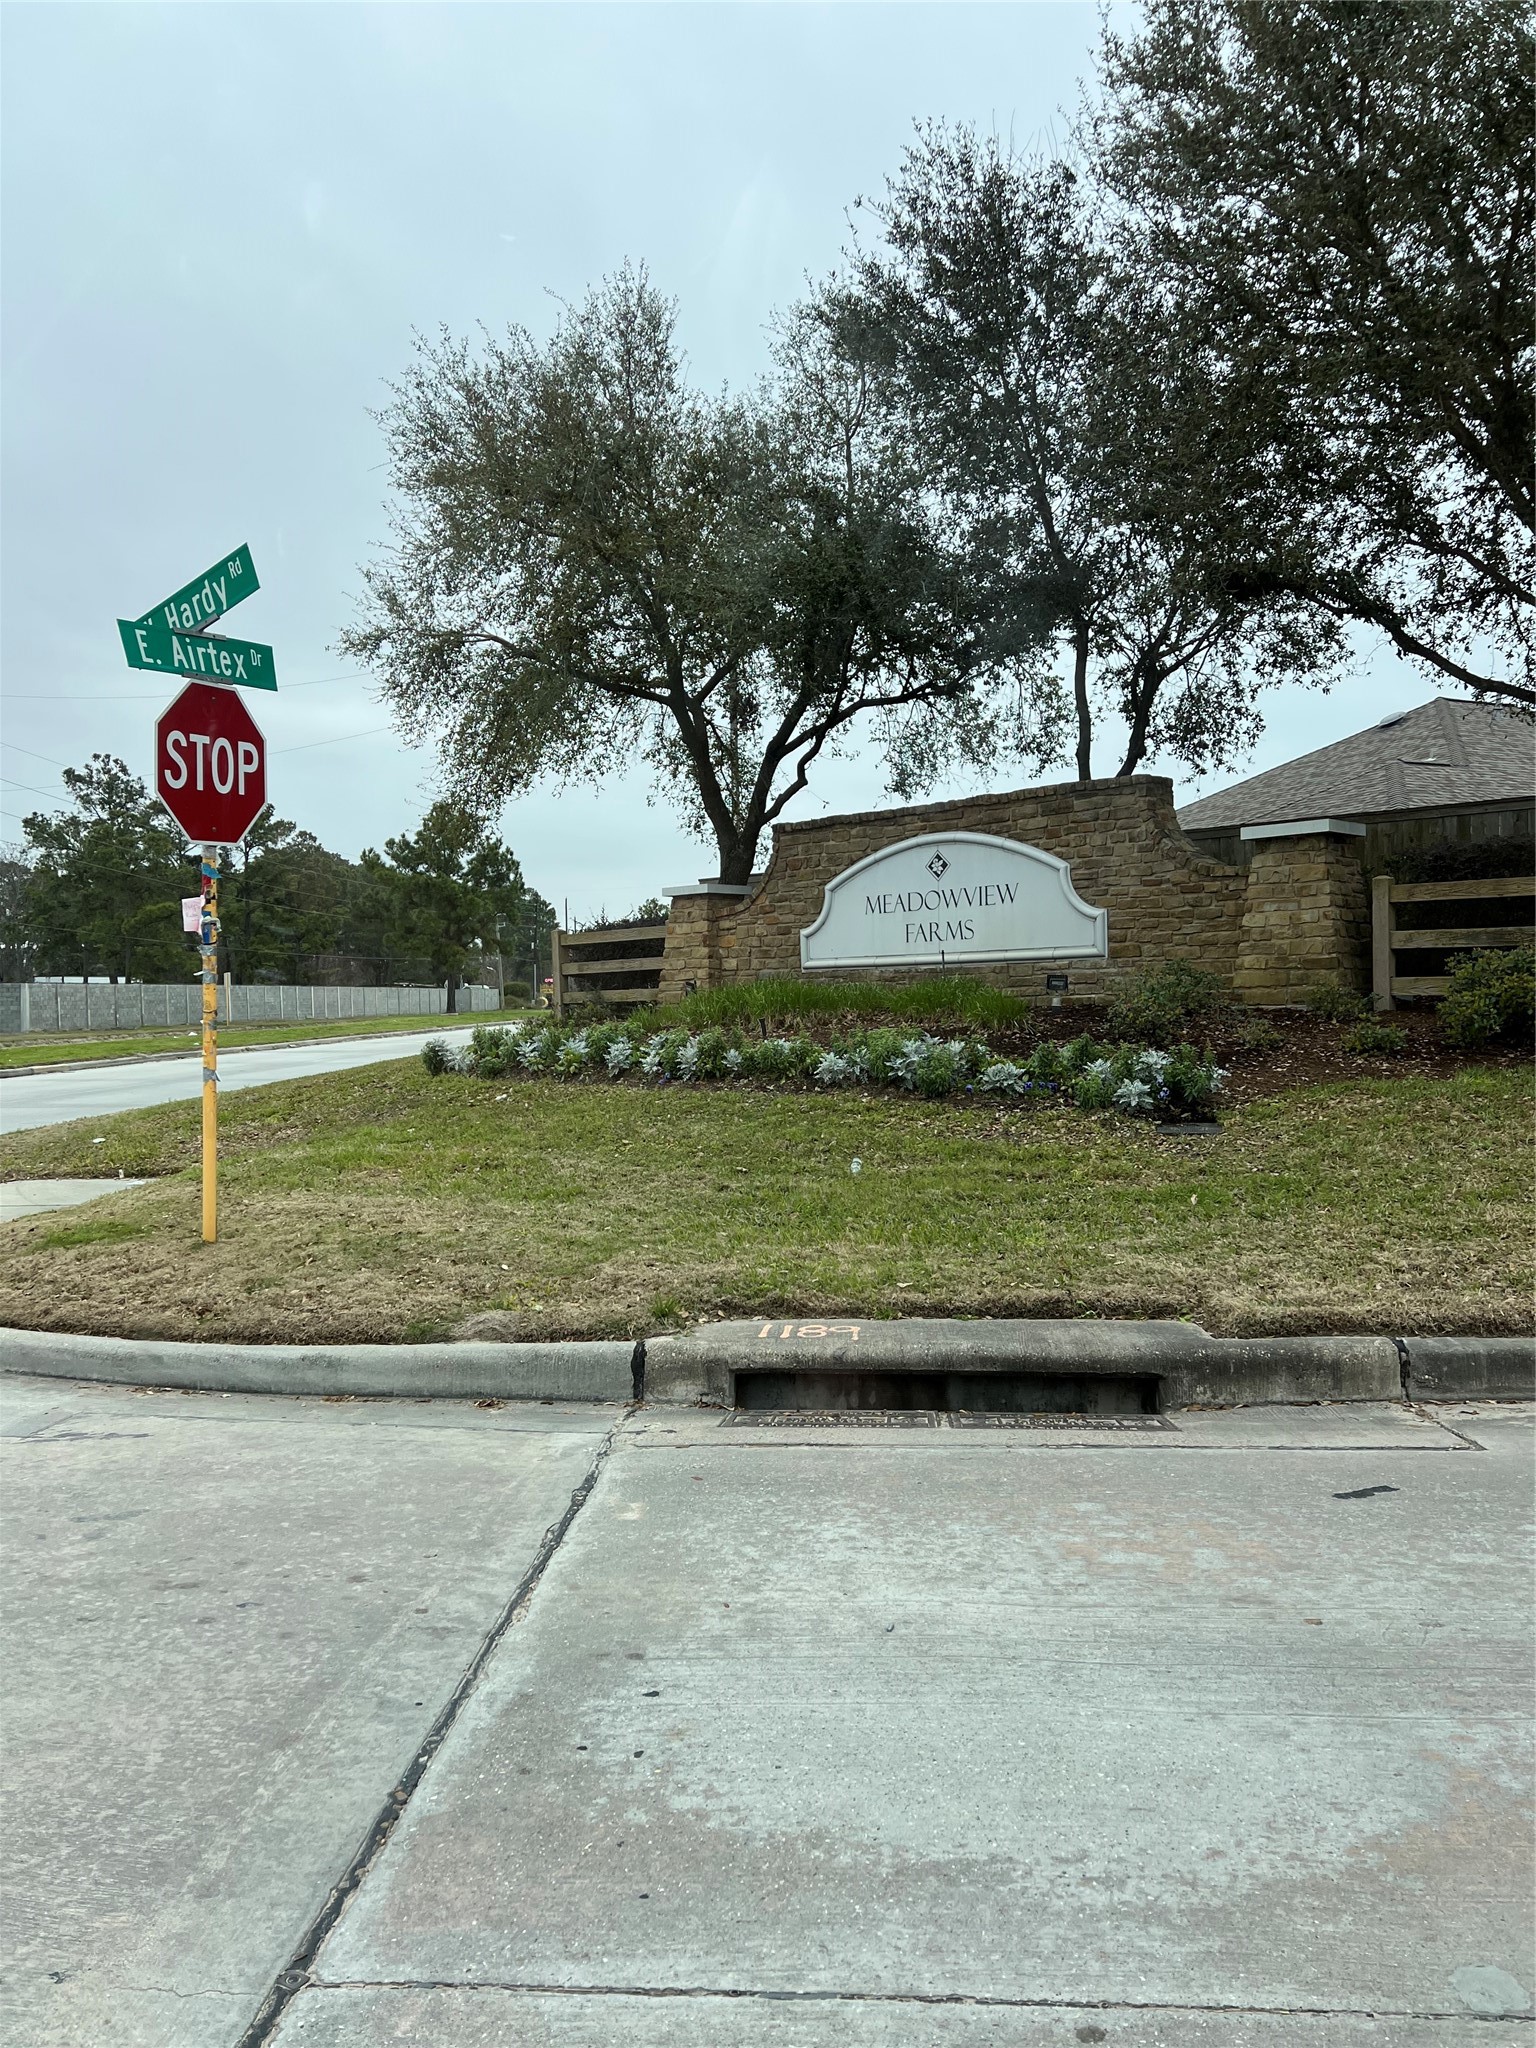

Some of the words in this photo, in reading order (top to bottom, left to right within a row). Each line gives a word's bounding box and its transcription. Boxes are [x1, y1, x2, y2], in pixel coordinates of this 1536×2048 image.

[165, 575, 228, 629] Hardy
[228, 557, 243, 579] Rd
[135, 629, 162, 665] E.
[172, 635, 248, 680] Airtex
[250, 648, 262, 667] Dr
[164, 730, 259, 796] STOP
[864, 883, 1020, 915] MEADOWVIEW
[905, 919, 975, 943] FARMS
[758, 1324, 861, 1341] 1189
